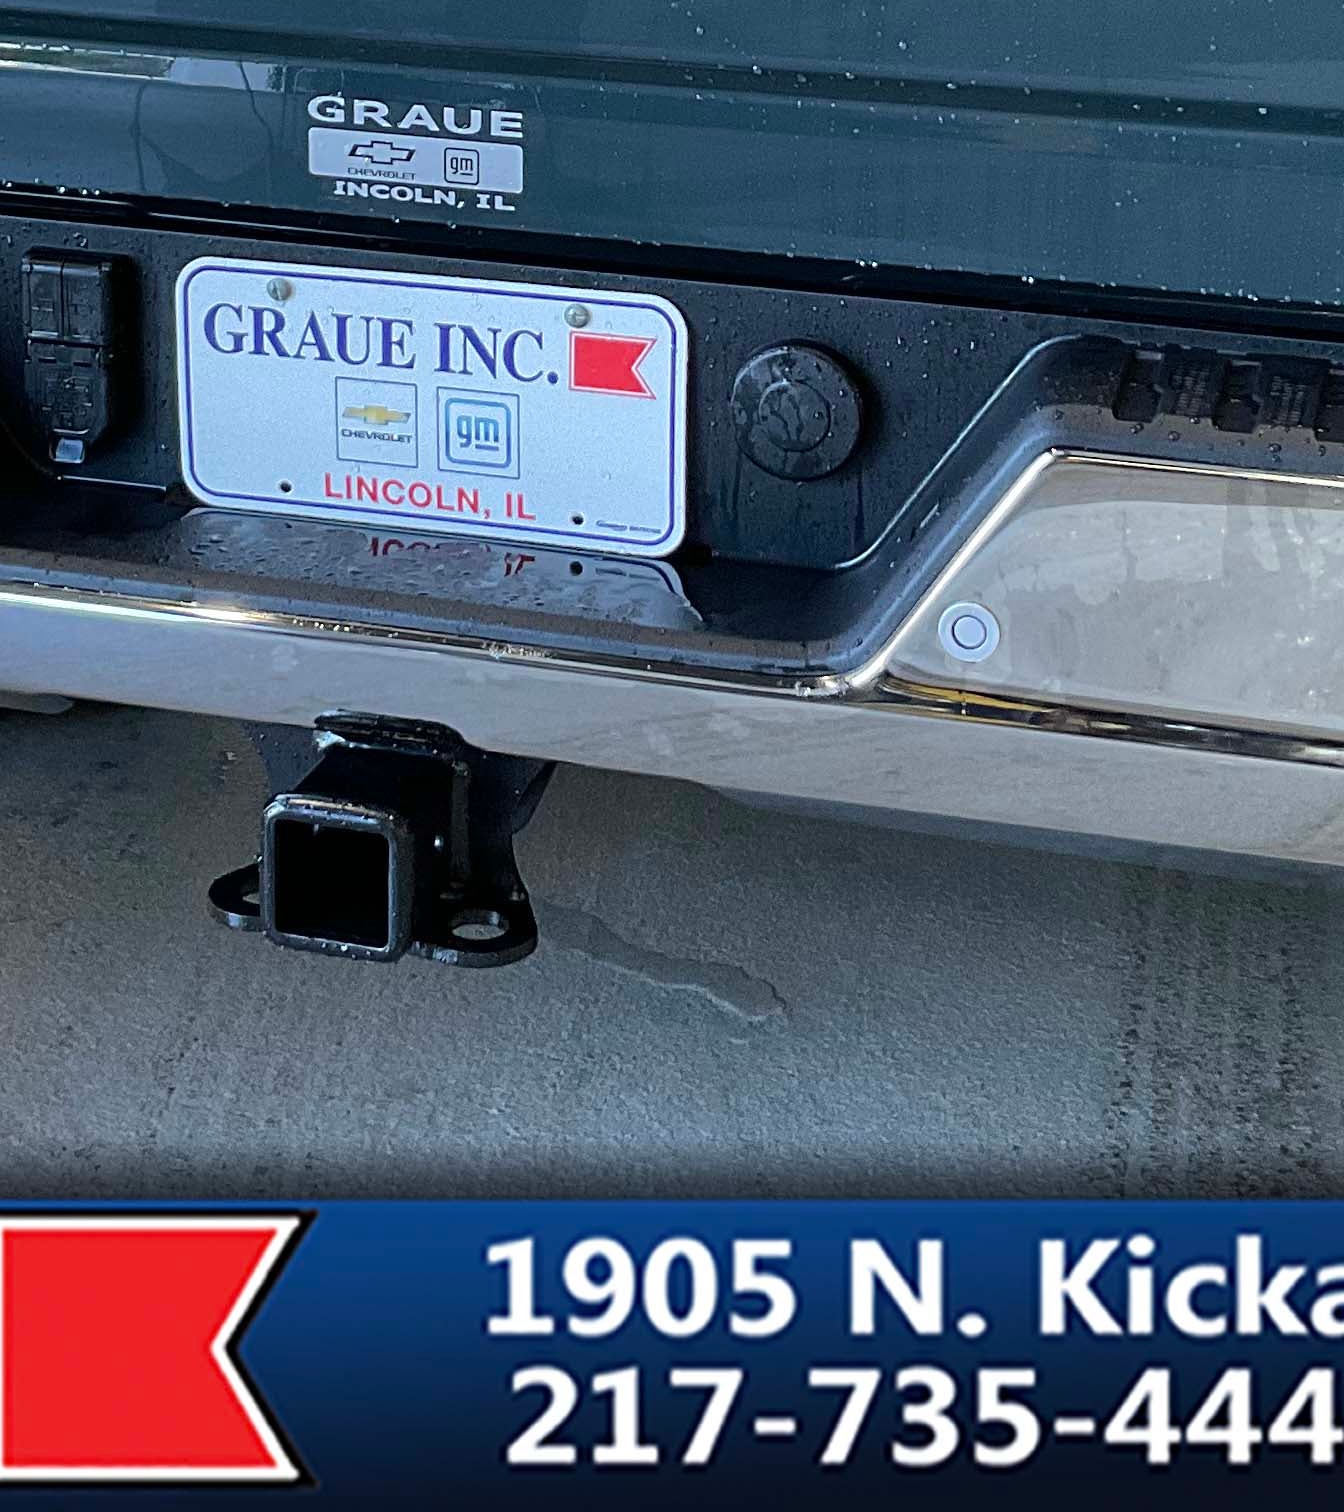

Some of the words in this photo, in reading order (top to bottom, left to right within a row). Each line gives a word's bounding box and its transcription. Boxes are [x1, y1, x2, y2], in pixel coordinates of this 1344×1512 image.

[307, 92, 524, 138] GRAUE
[347, 166, 417, 181] CHEVROLET
[449, 155, 474, 176] gm
[475, 193, 516, 212] IL
[203, 302, 416, 369] GRAUE
[433, 322, 559, 385] INC.
[341, 428, 413, 444] CHEVROLET
[456, 414, 500, 452] gm
[324, 472, 492, 519] LINCOLN,
[505, 491, 537, 521] IL
